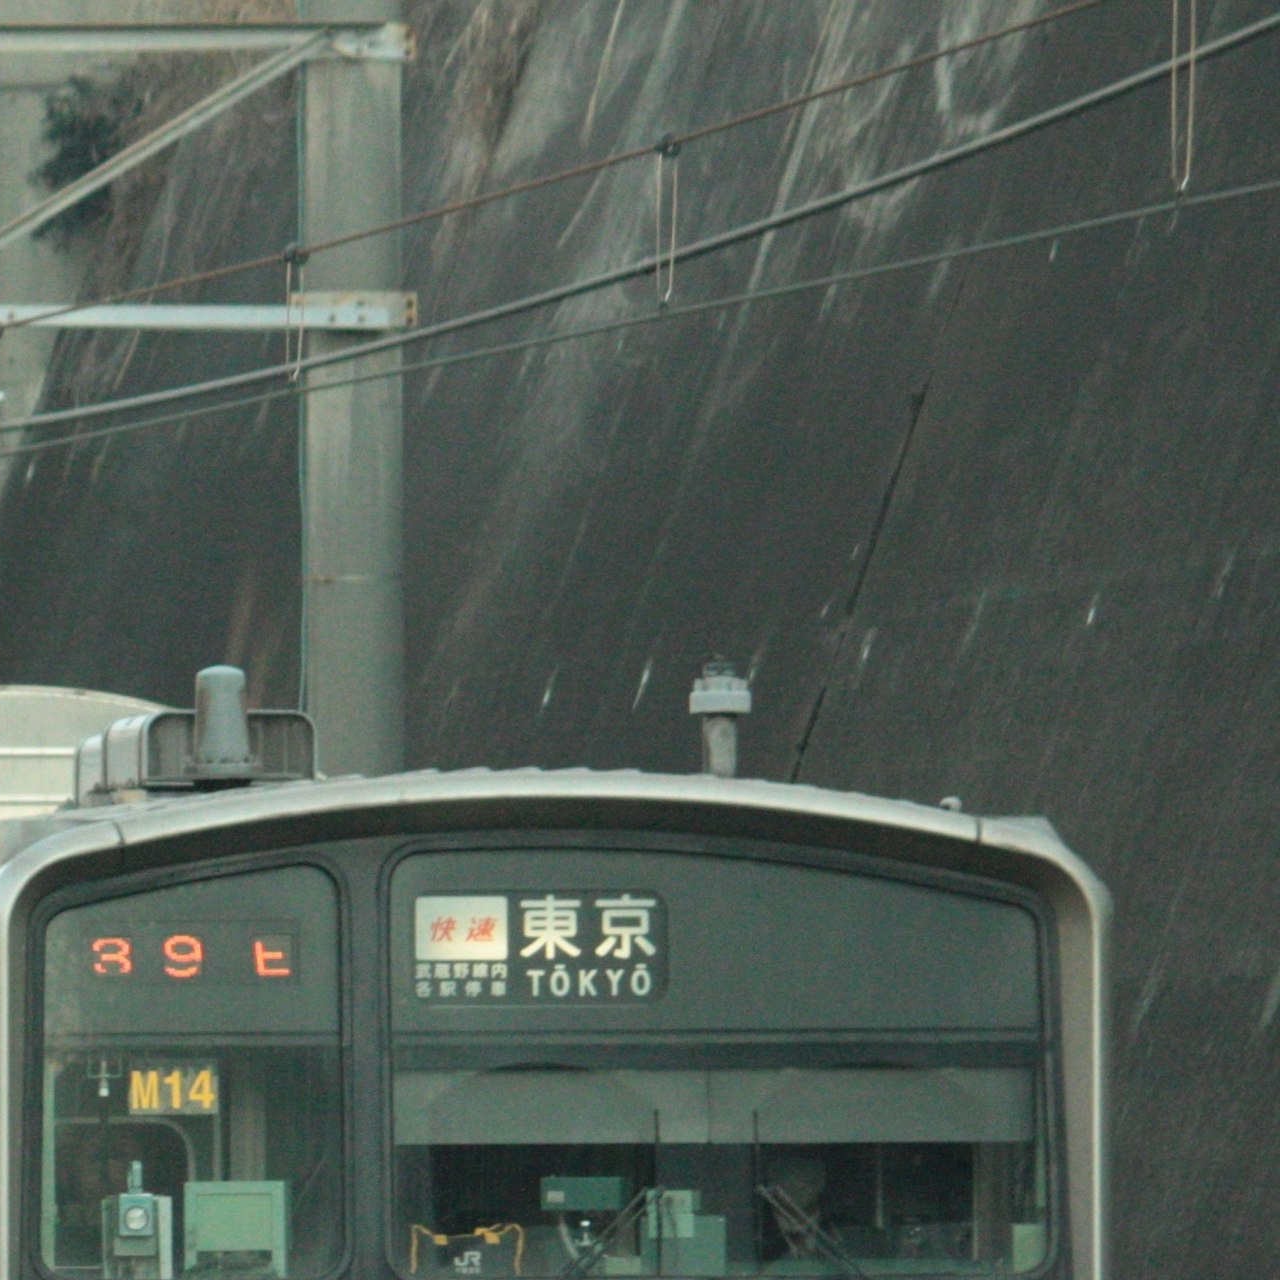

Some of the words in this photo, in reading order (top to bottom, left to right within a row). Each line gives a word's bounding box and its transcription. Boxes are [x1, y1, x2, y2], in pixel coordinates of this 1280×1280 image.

[429, 915, 498, 943] 快速
[519, 893, 658, 960] 東京
[130, 1069, 216, 1110] M14
[453, 1250, 482, 1267] JR
